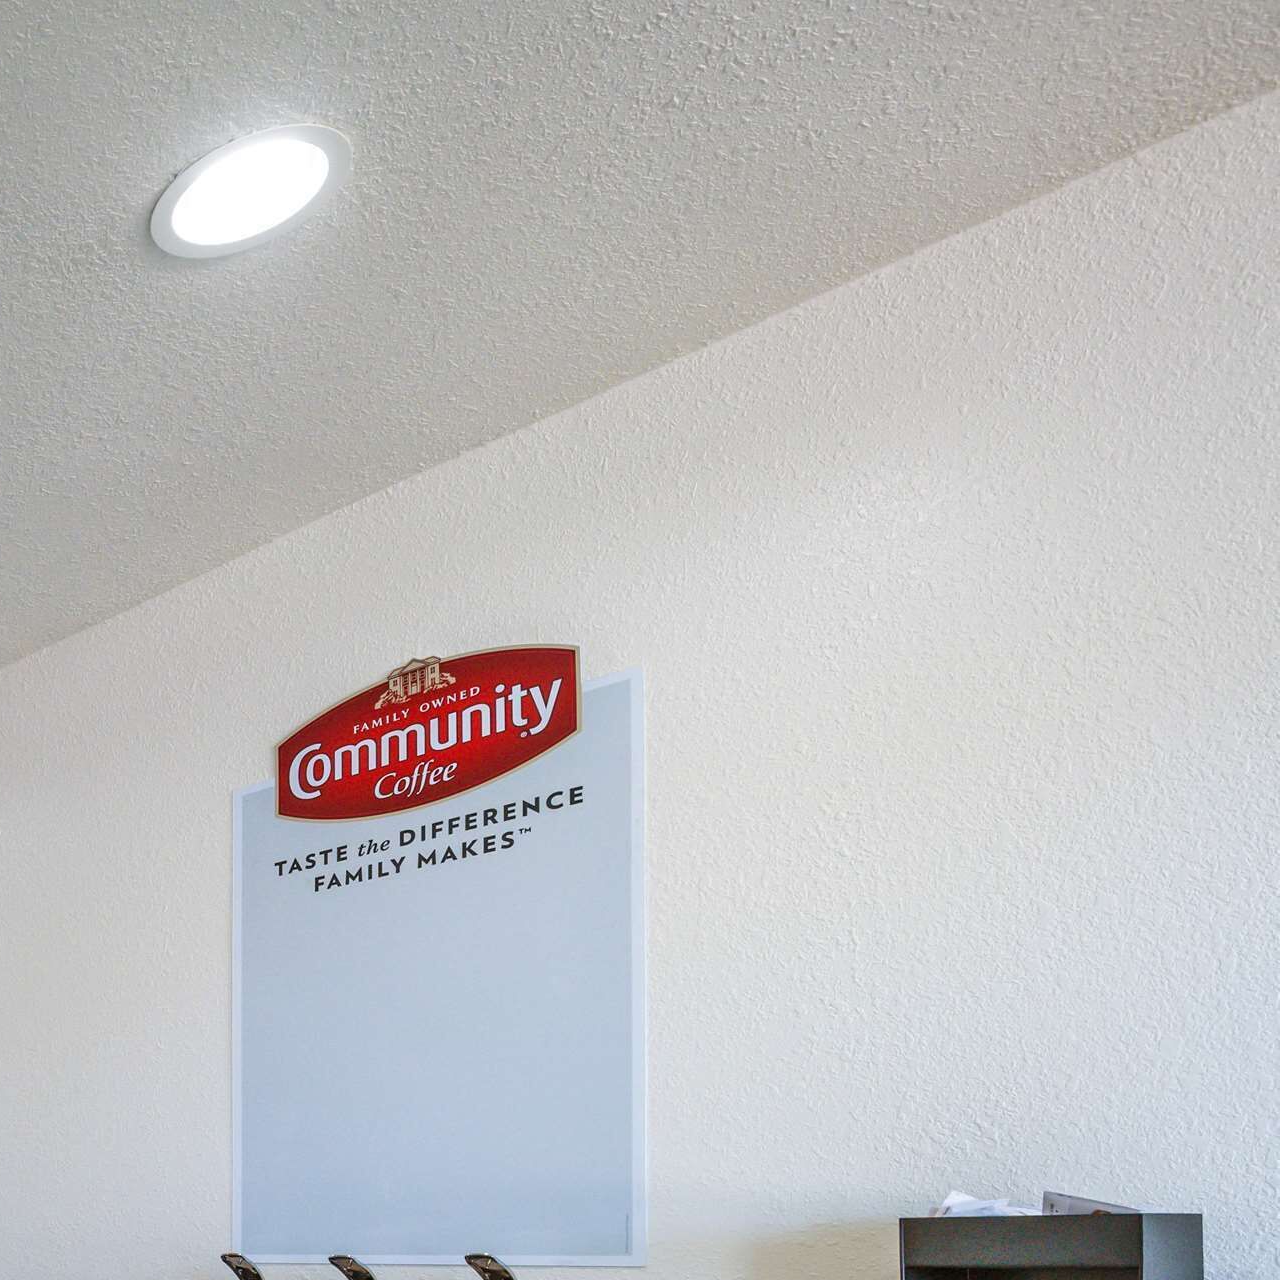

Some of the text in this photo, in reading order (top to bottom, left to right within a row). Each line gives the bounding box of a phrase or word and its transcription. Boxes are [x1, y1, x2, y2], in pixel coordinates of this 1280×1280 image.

[352, 686, 480, 735] FAMILY OWNED
[288, 678, 563, 800] Community
[373, 758, 458, 800] Coffee
[274, 785, 585, 877] TASTE the DIFFERENCE
[314, 856, 406, 892] FAMILY
